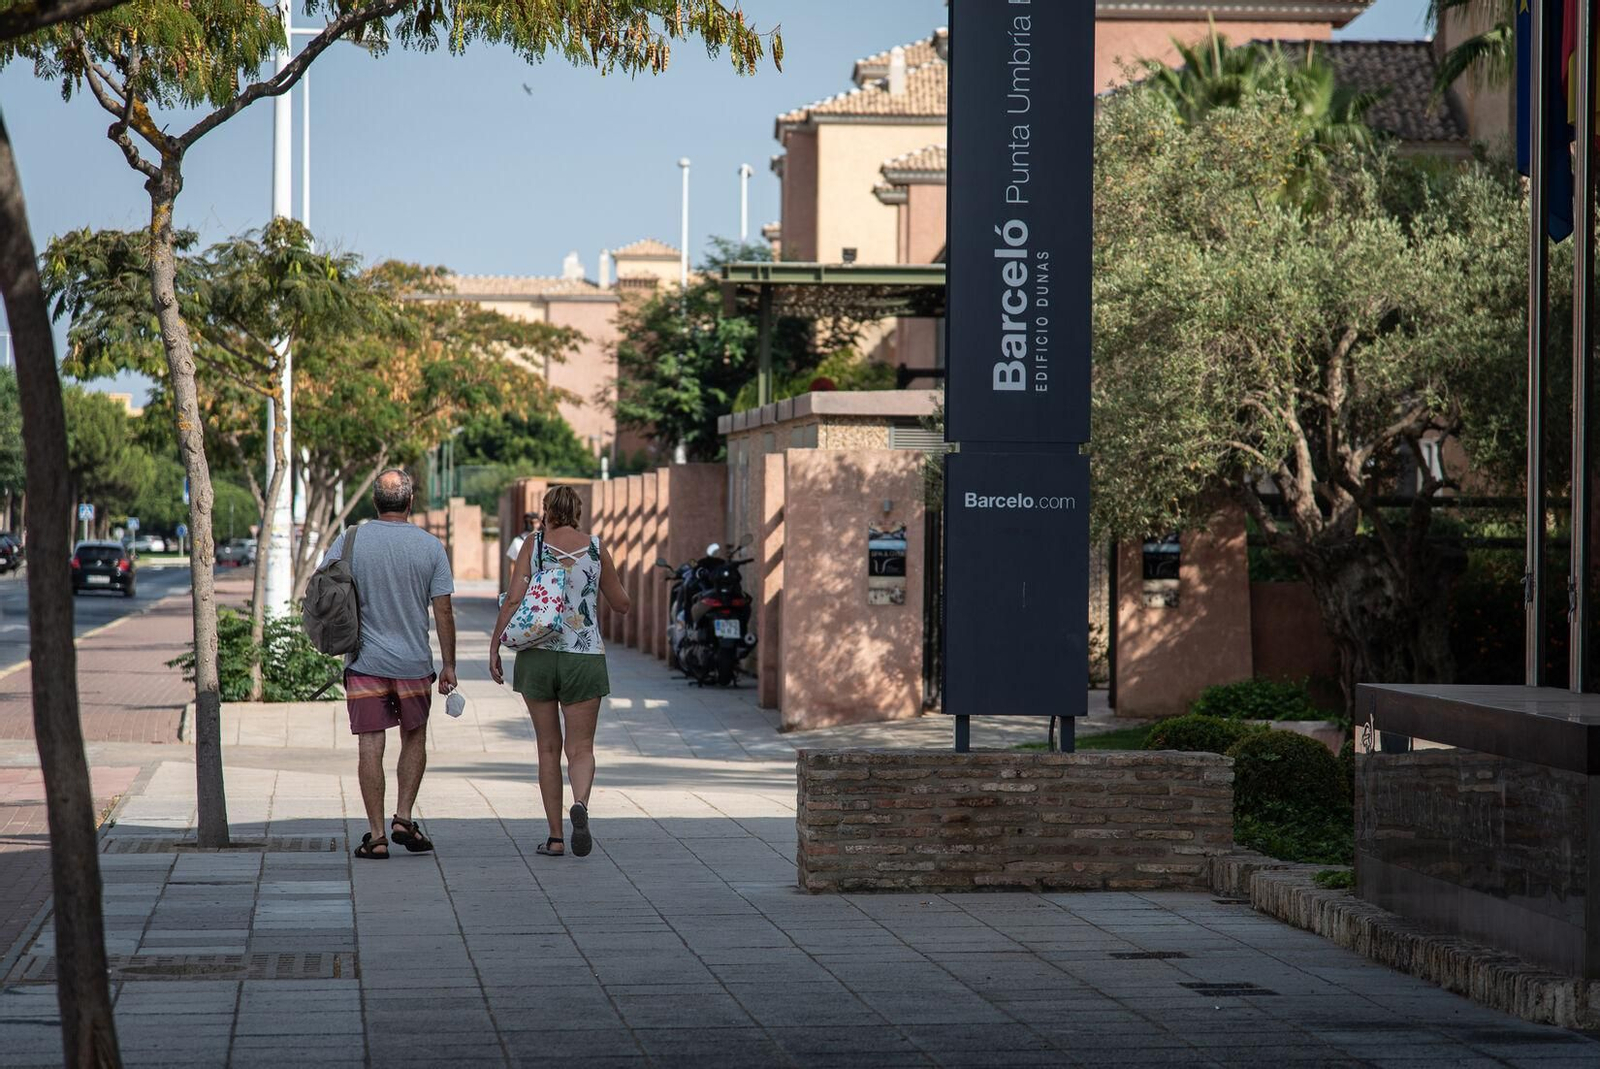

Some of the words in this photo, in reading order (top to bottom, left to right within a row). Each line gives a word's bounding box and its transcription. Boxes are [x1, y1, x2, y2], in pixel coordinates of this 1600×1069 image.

[1006, 14, 1032, 114] Umbría
[1005, 123, 1030, 204] Punta
[992, 219, 1029, 391] Barceló
[1036, 251, 1049, 307] DUNAS
[1035, 316, 1049, 392] EDIFICIO
[964, 492, 1075, 509] Barcelo.com
